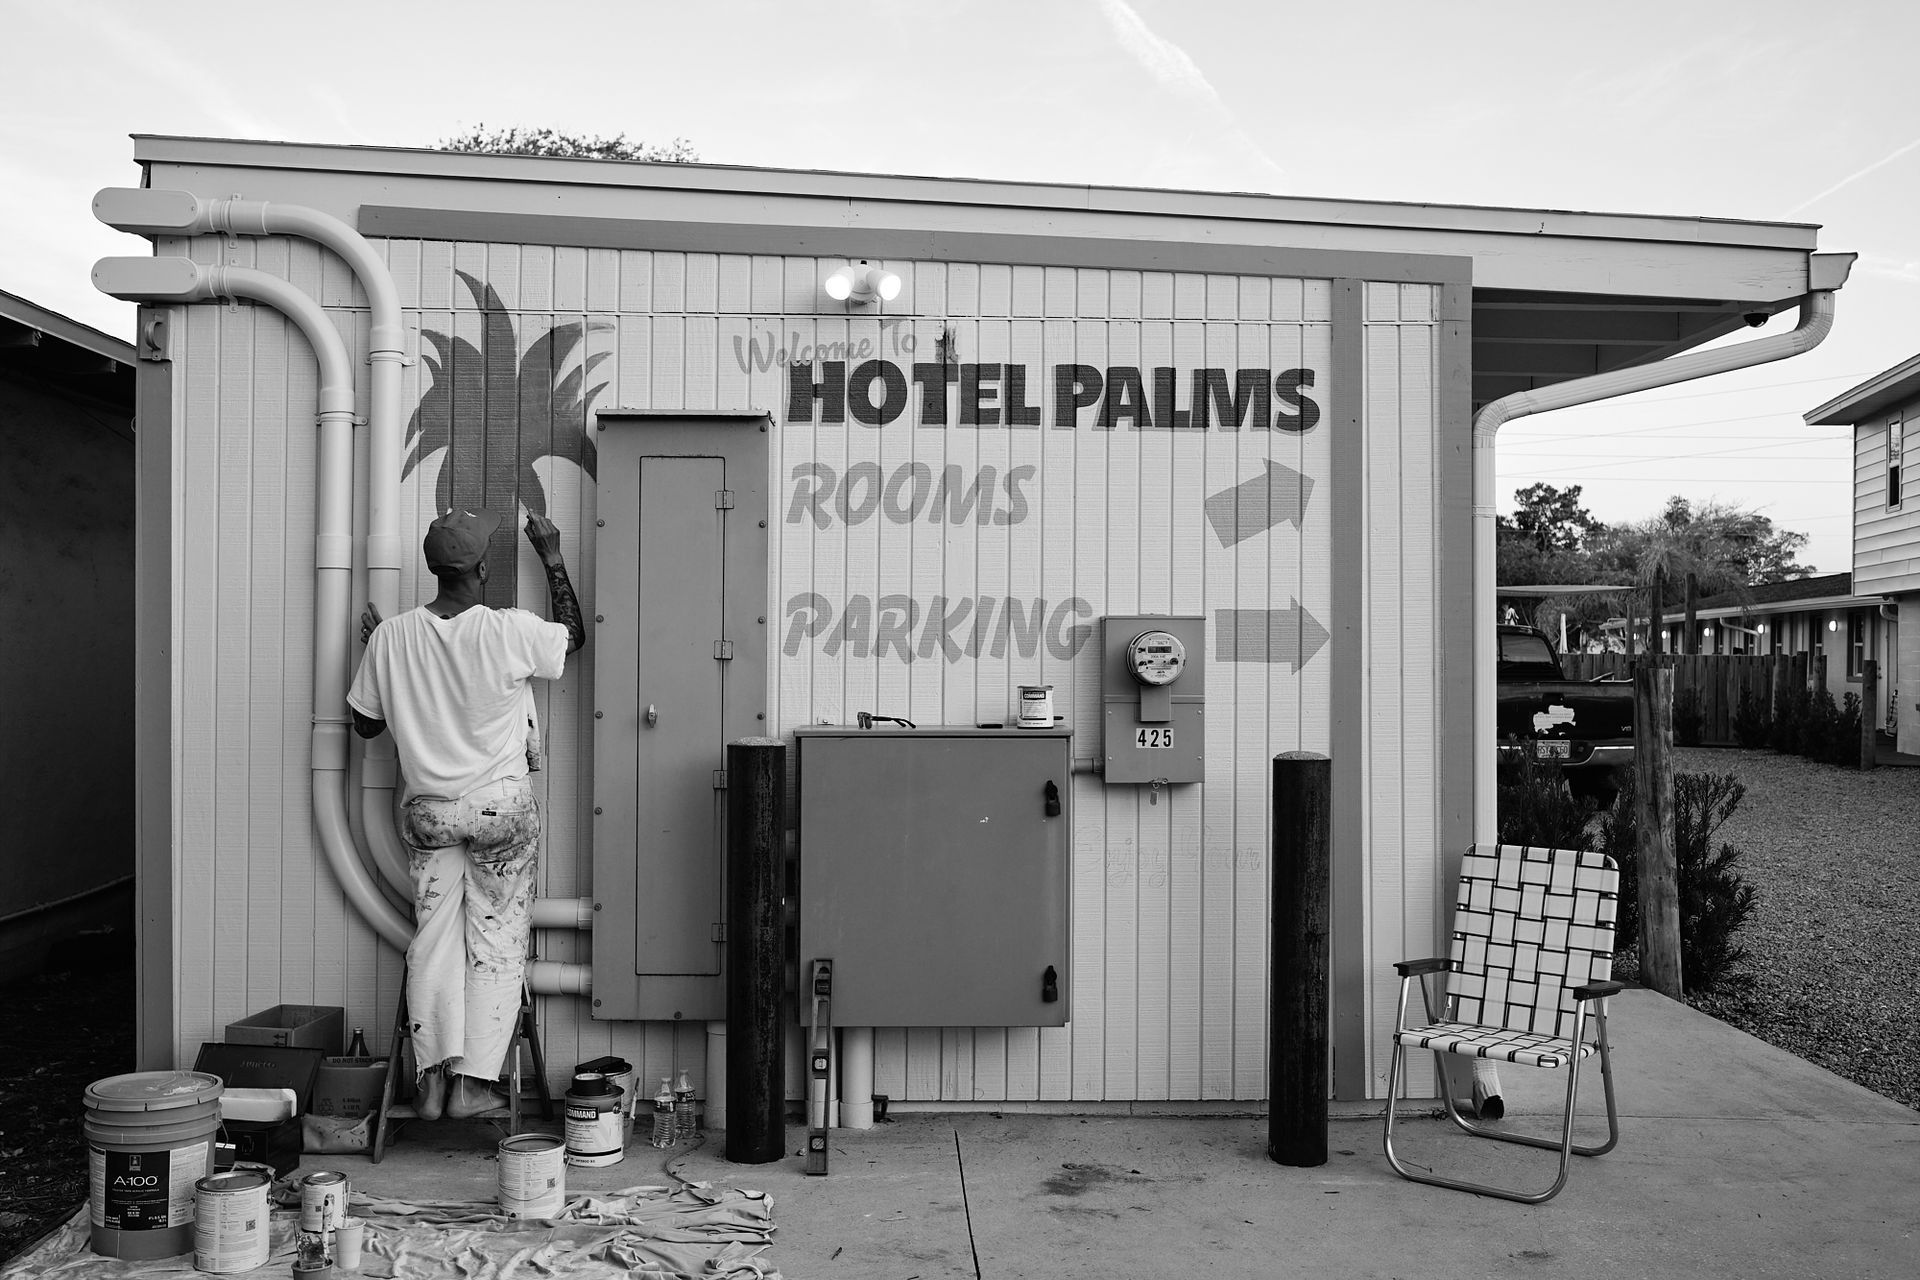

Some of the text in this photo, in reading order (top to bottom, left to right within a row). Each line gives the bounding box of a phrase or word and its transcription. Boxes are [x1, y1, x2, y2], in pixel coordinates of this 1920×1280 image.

[733, 317, 917, 374] Welcome To
[784, 359, 1320, 436] HOTEL PALMS
[786, 462, 1036, 530] ROOMS
[783, 592, 1093, 664] PARKING
[1138, 729, 1171, 747] 425
[566, 1107, 597, 1119] COMMAND
[114, 1175, 158, 1187] A-100
